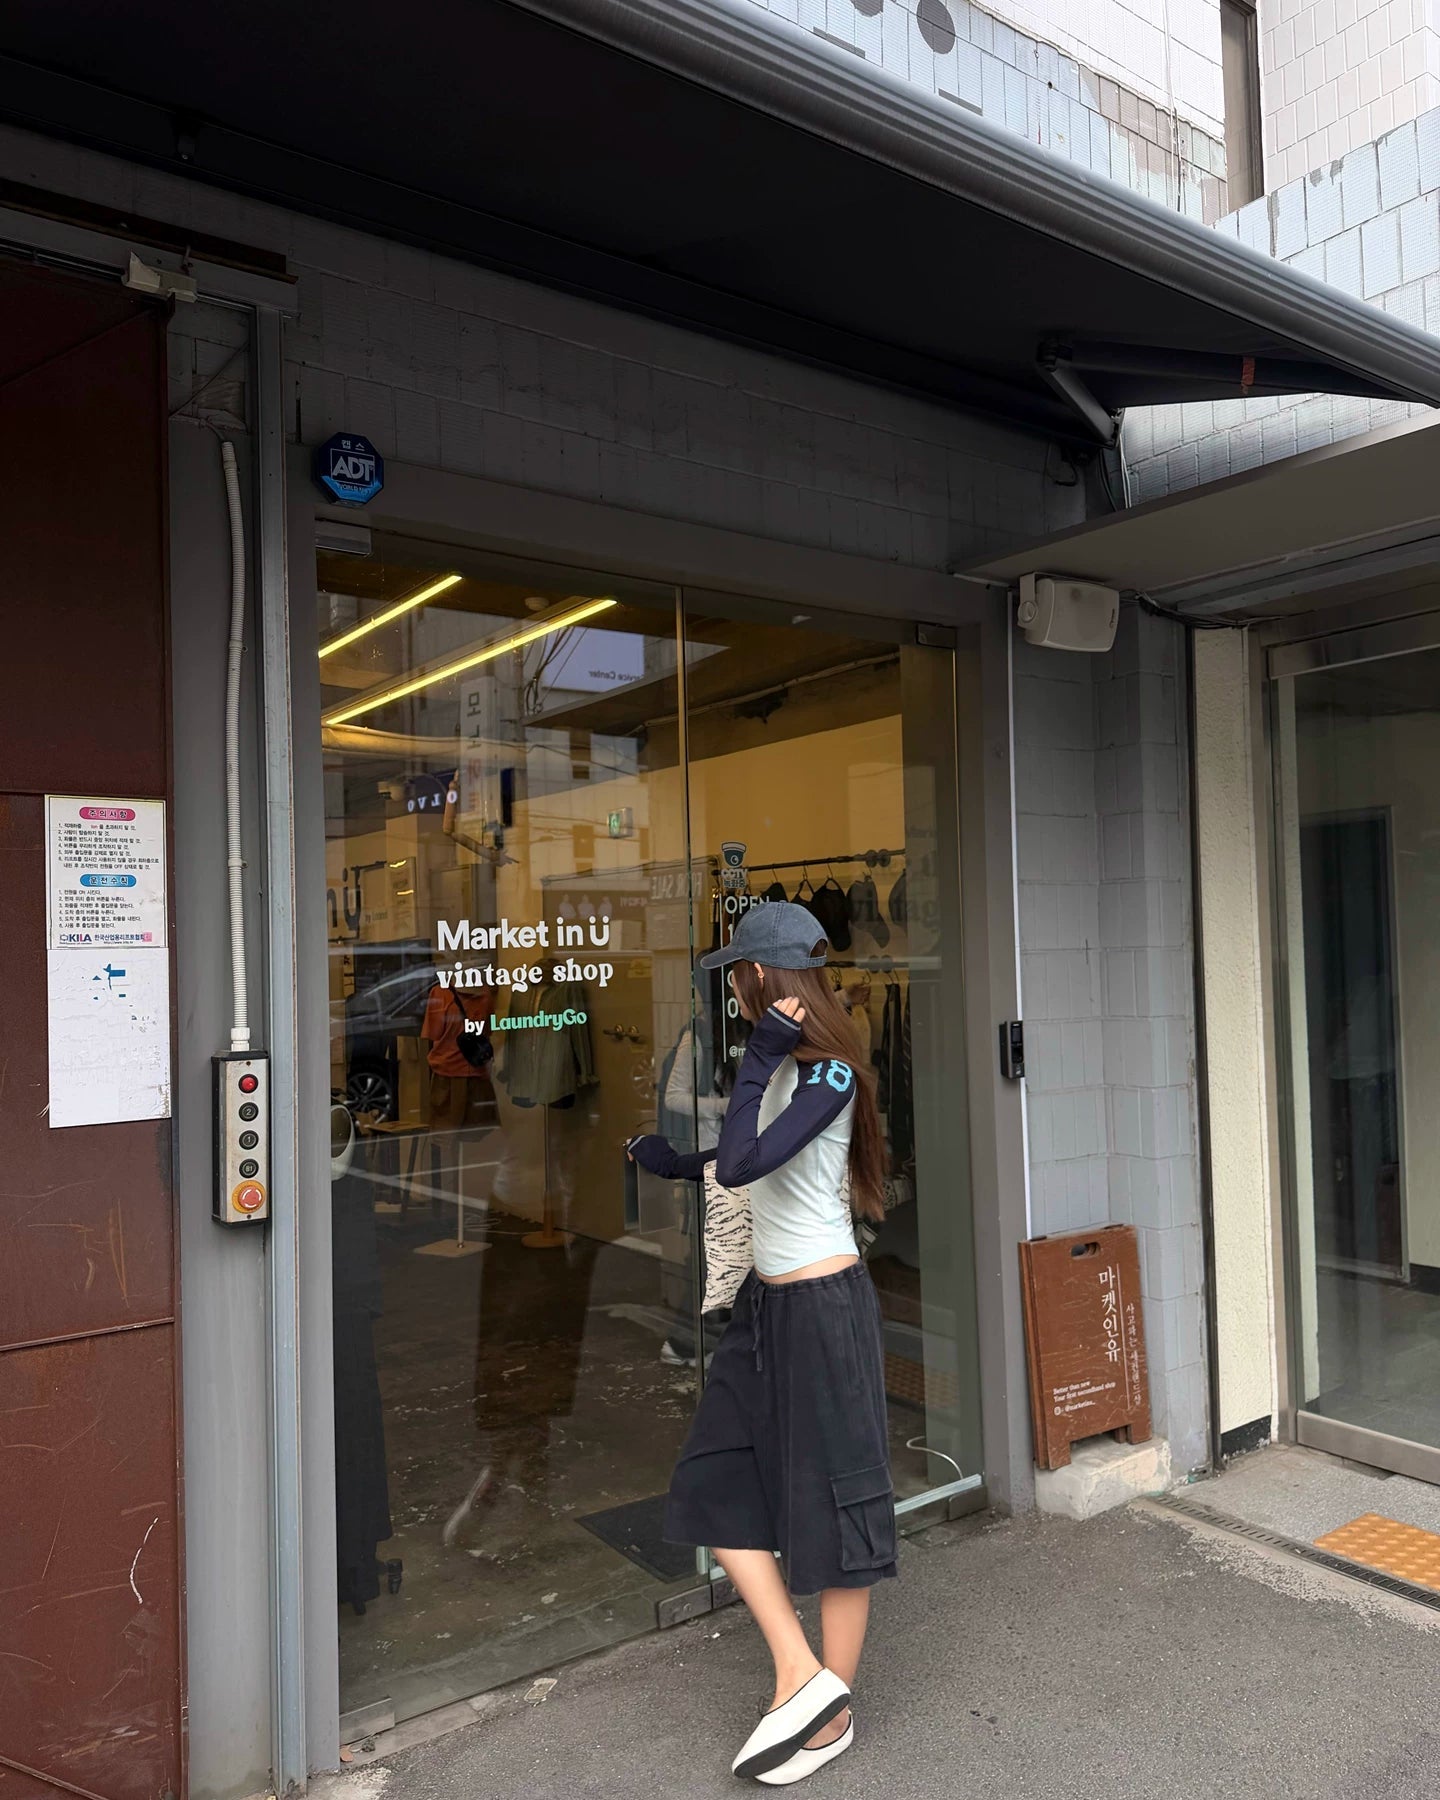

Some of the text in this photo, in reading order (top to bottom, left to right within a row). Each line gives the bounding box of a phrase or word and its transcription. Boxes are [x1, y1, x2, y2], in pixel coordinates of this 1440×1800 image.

[332, 455, 374, 482] ADT
[89, 809, 127, 819] 주의사항
[90, 876, 128, 885] 운전수칙
[721, 868, 748, 879] CCTV
[69, 933, 92, 942] KILA
[437, 915, 610, 951] Market in Ü
[436, 958, 614, 993] vintage shop
[464, 1008, 587, 1036] by LaundryGo
[806, 1059, 852, 1092] 18
[1098, 1265, 1121, 1362] 마켓인유
